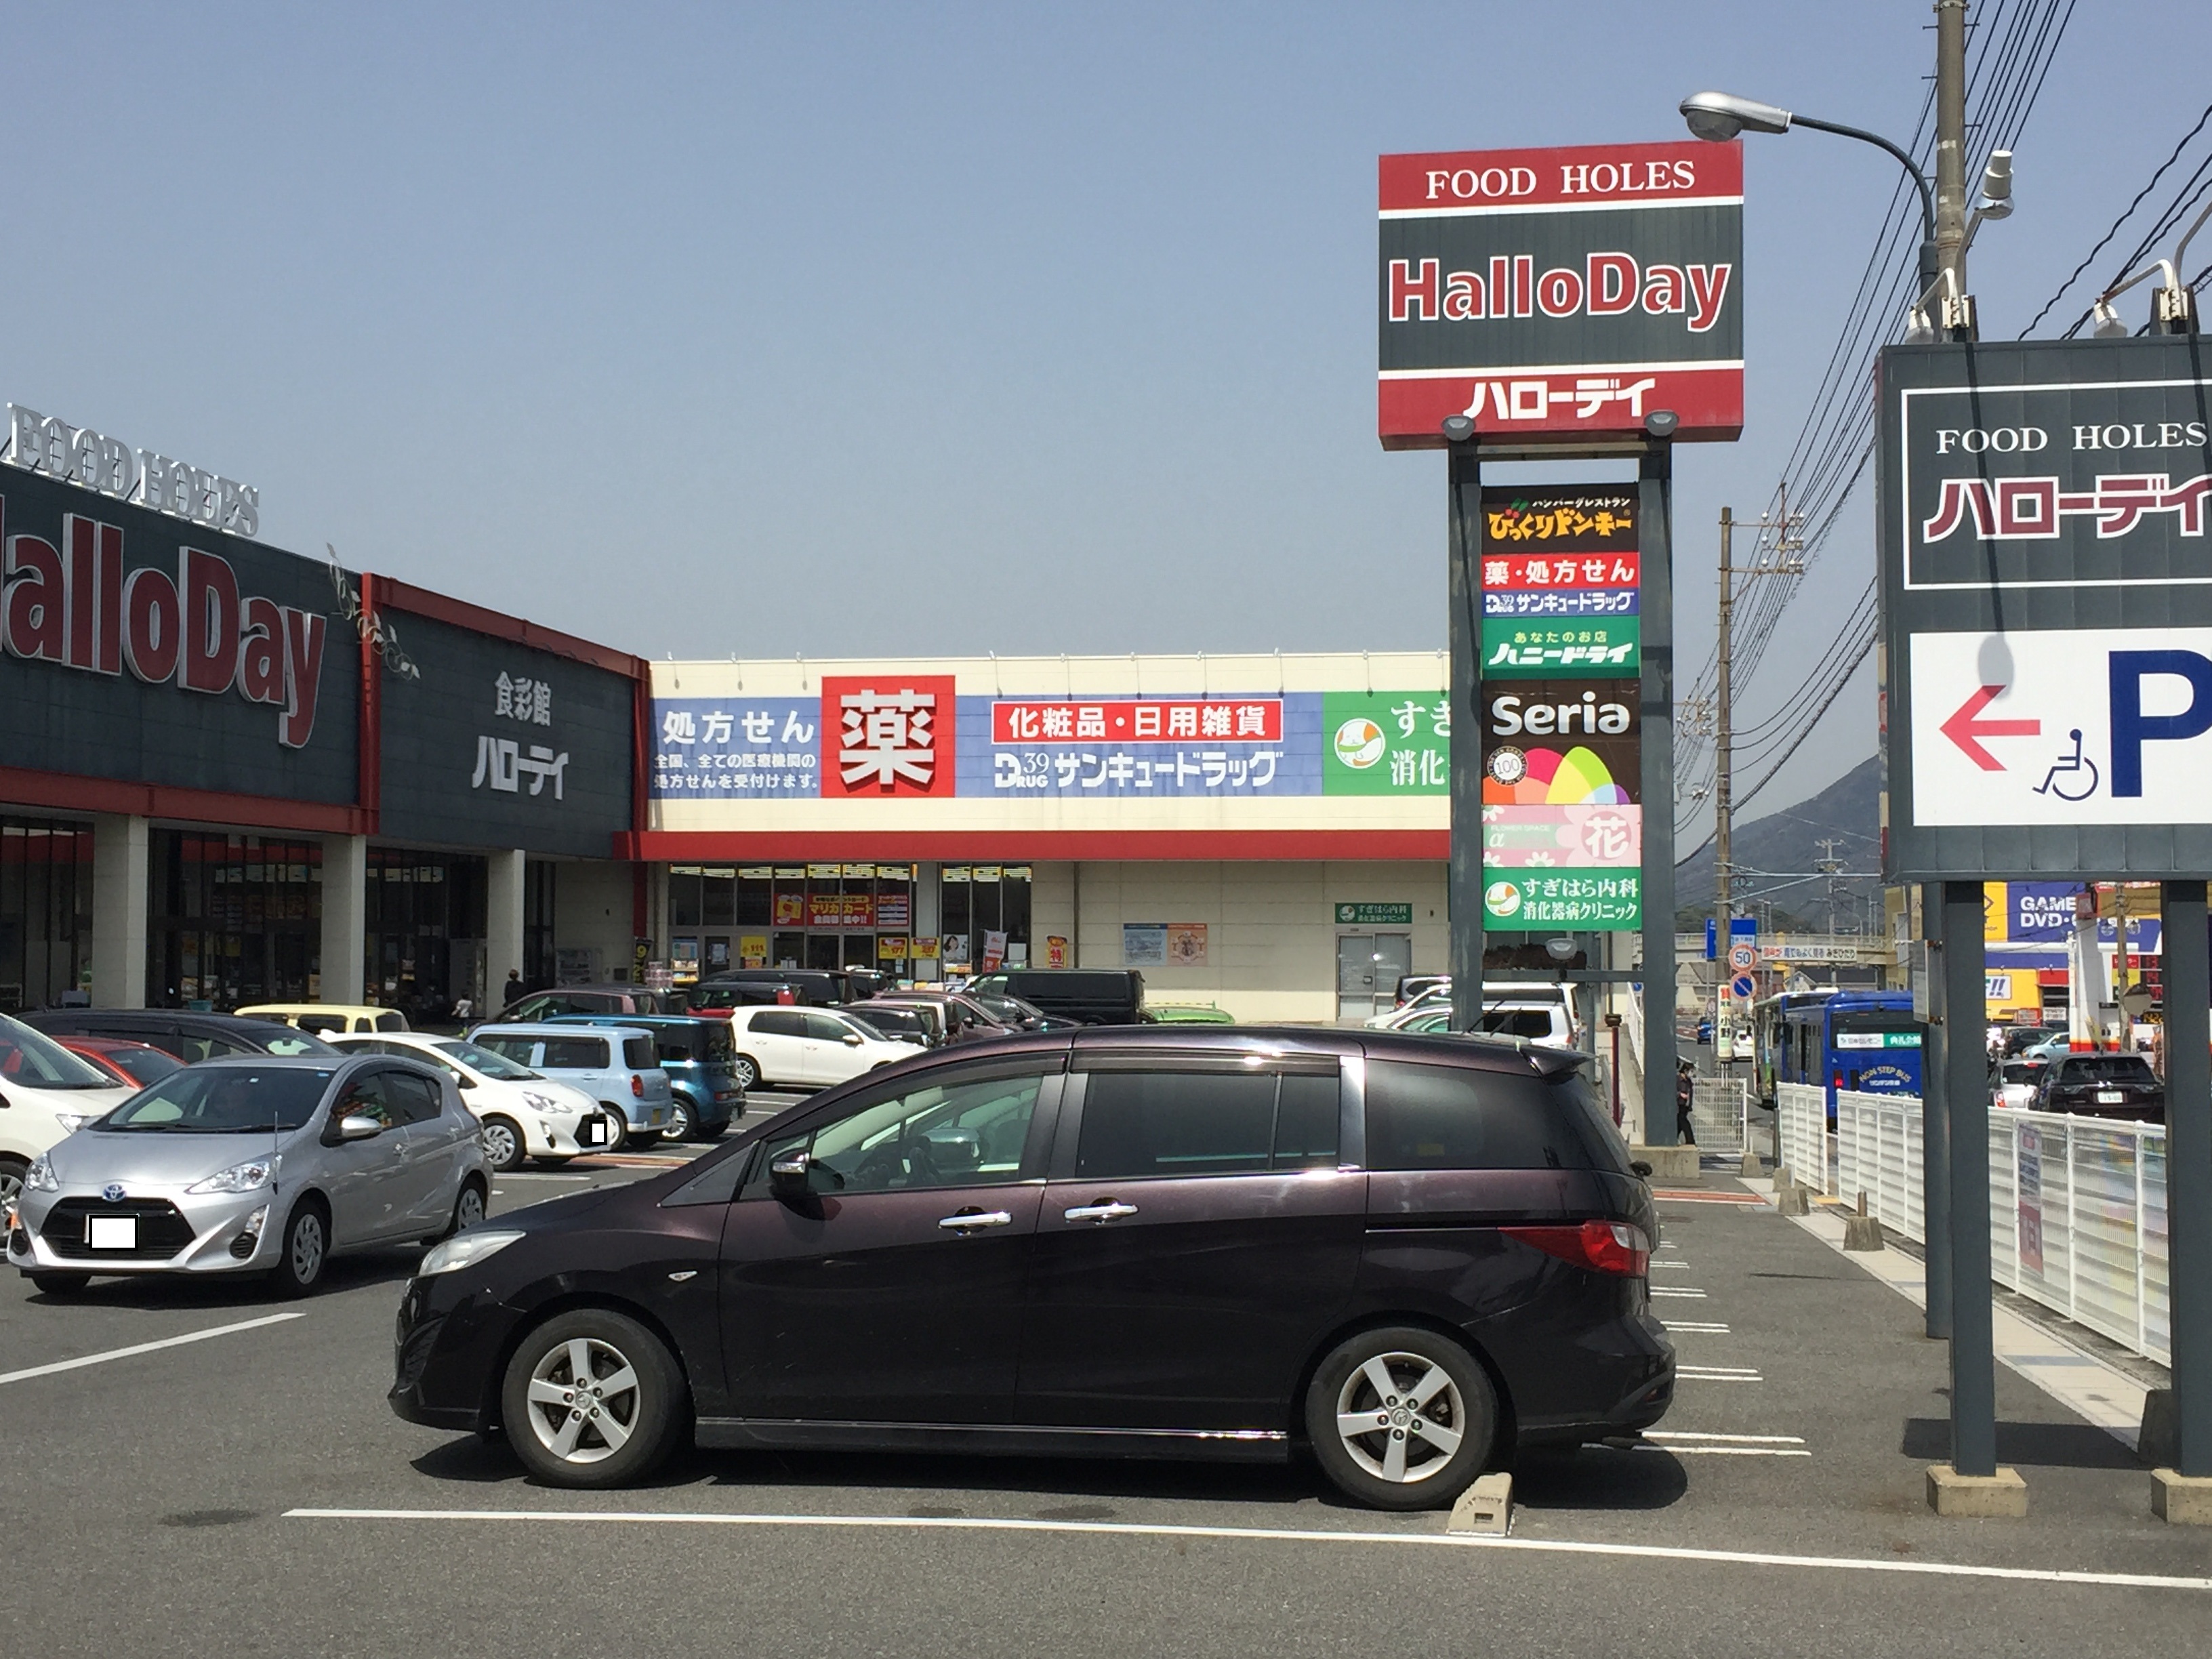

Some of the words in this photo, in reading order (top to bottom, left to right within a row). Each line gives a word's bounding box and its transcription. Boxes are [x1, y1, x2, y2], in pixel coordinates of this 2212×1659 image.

[1426, 167, 1537, 199] FOOD
[1560, 161, 1696, 193] HOLES
[1389, 251, 1732, 333] HalloDay
[1936, 427, 2048, 455] FOOD
[2072, 422, 2207, 450] HOLES
[5, 401, 134, 499] FOOD
[137, 447, 260, 537] HOLES
[1532, 497, 1631, 508] ハンバーグレストラン
[1488, 508, 1633, 541] びっくりドンキー
[1485, 558, 1635, 585] 薬・処方せん
[1517, 592, 1635, 613] サンキュードラッグ
[0, 493, 327, 749] alloDay
[1514, 631, 1607, 643] あなたのお店
[1488, 643, 1633, 665] ハニードライ
[495, 672, 552, 726] 食彩館
[1492, 691, 1630, 735] Seria
[663, 710, 815, 745] 処方せん
[840, 689, 935, 785] 薬
[1009, 706, 1267, 738] 化粧品・日用雑貨
[2108, 649, 2212, 798] P
[1023, 752, 1050, 774] 39
[1054, 751, 1284, 788] サンキュードラッグ
[1390, 749, 1450, 786] 消化
[1495, 758, 1521, 775] 100
[654, 773, 817, 789] 処方せんを受付けます。
[1585, 817, 1630, 859] 花
[1522, 878, 1637, 897] すぎはら内科
[2020, 896, 2076, 912] GAME
[1523, 901, 1637, 920] 消化器病クリニック
[1735, 951, 1751, 964] 50
